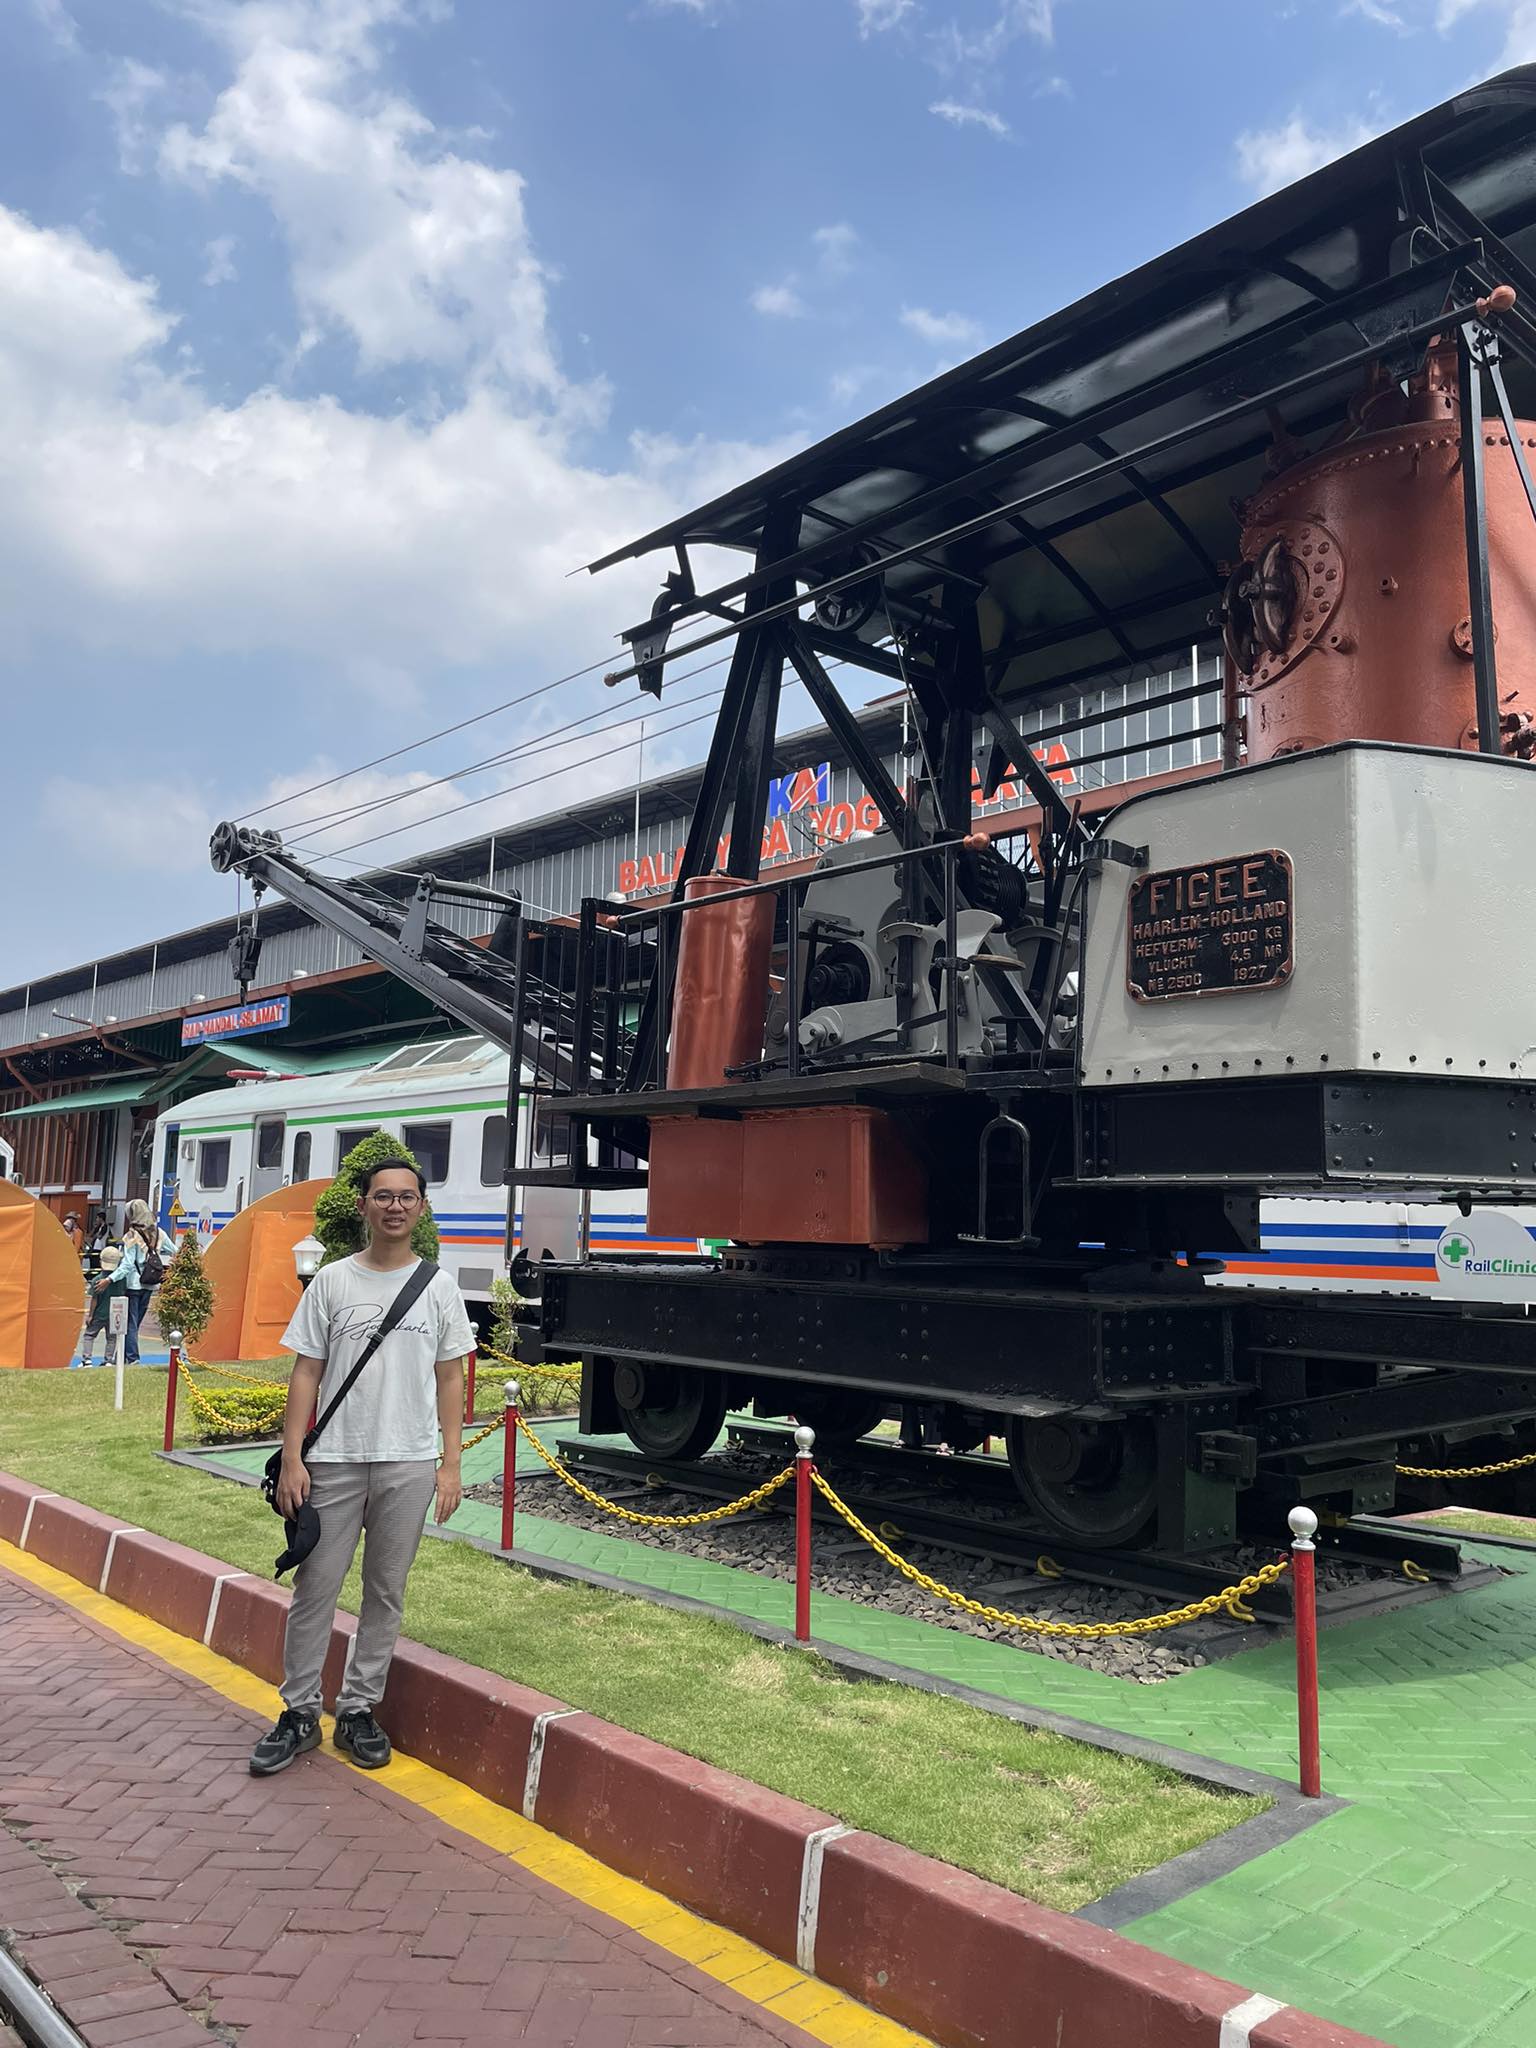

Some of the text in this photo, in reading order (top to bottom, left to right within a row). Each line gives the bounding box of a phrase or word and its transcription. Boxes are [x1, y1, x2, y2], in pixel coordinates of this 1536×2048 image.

[769, 762, 830, 817] KAI
[1151, 860, 1267, 916] FIGEE
[1167, 973, 1202, 990] 2500
[1233, 964, 1268, 981] 1927
[330, 1303, 431, 1342] Djokarta
